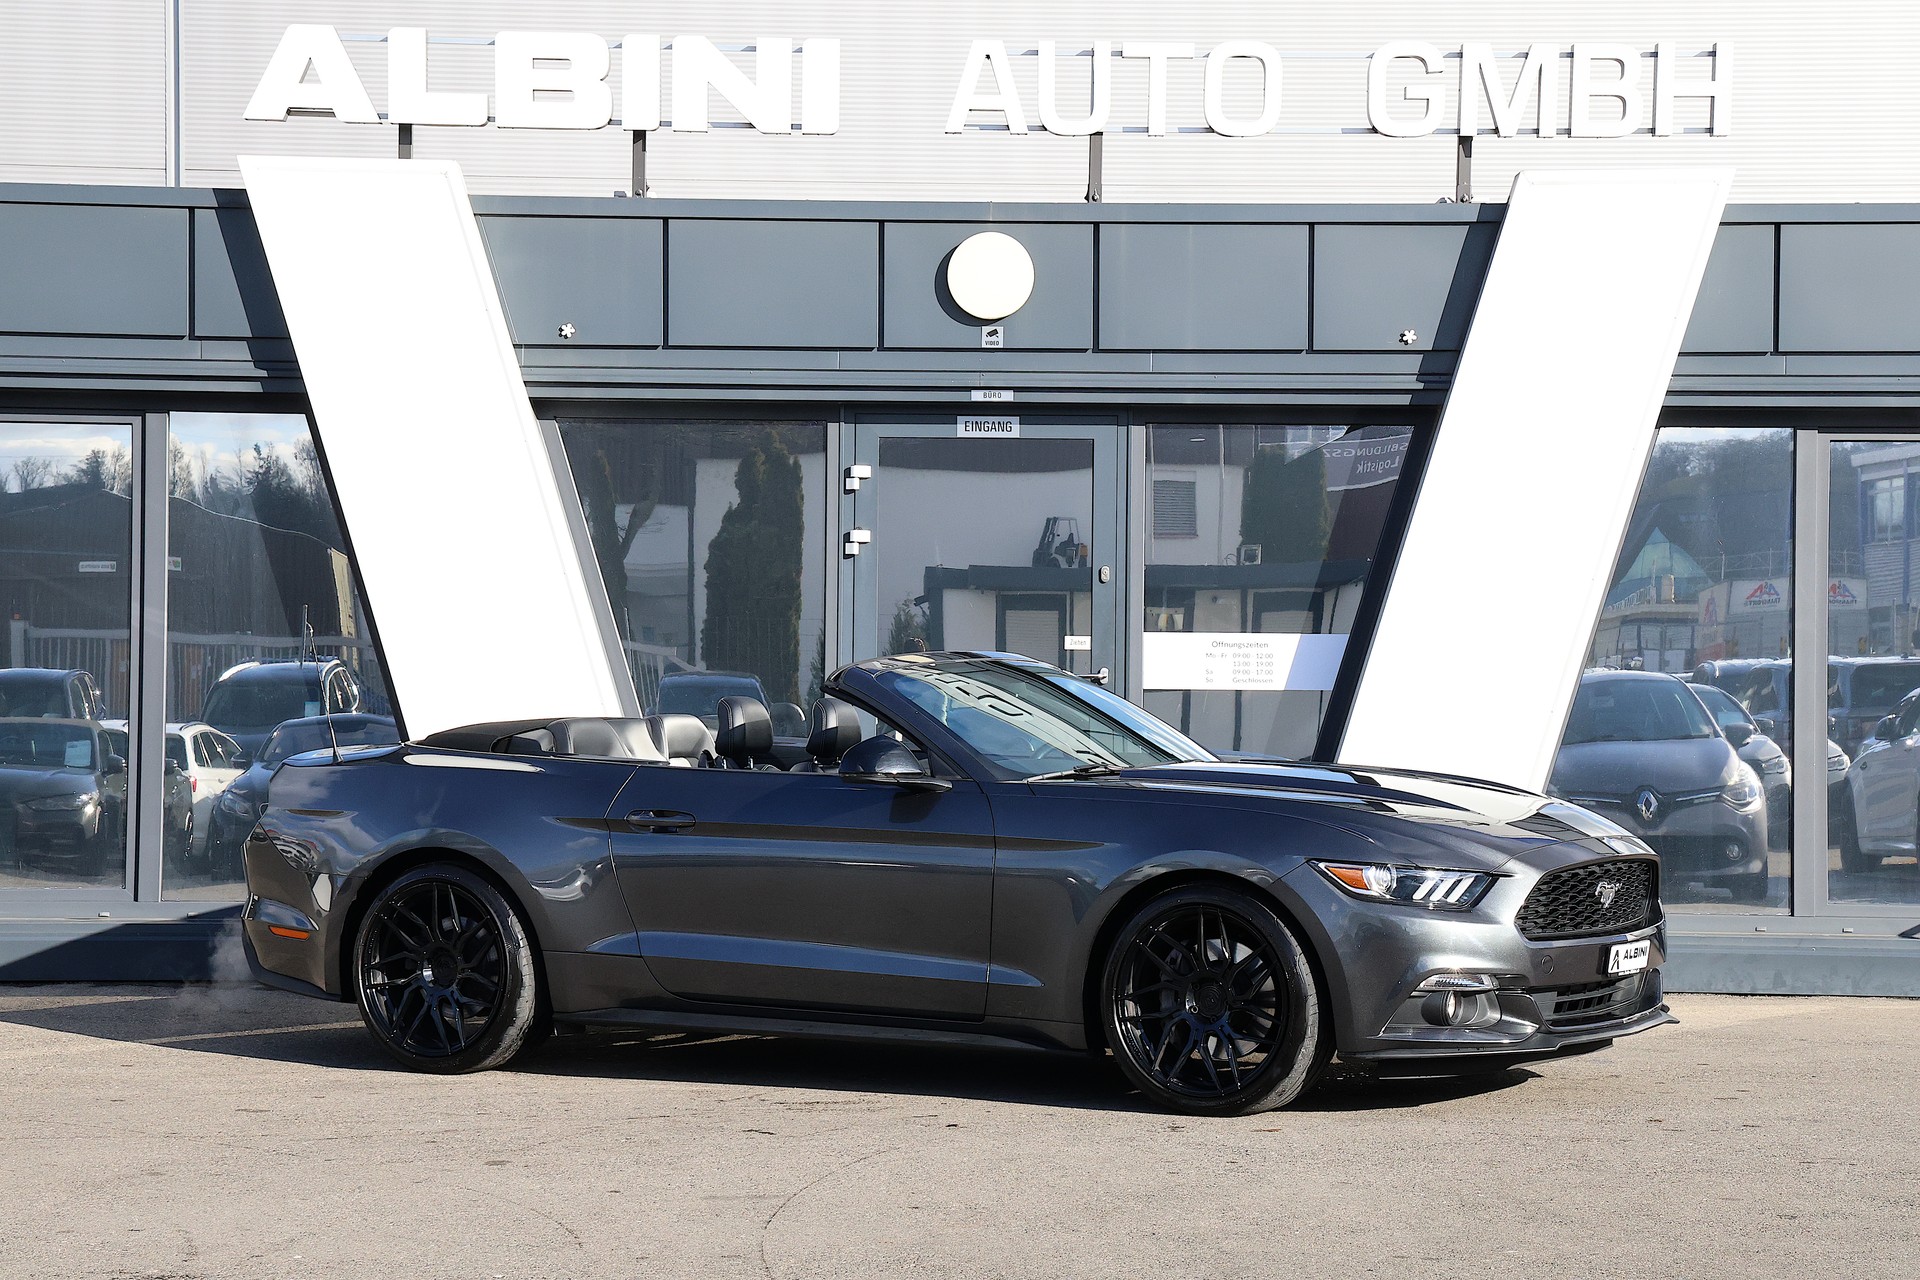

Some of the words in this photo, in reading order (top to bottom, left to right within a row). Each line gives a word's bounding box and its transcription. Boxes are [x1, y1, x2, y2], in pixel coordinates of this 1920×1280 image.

[242, 24, 841, 136] ALBINI
[945, 38, 1284, 138] AUTO
[1367, 40, 1734, 138] GMBH
[982, 391, 1002, 399] BÜRO
[964, 421, 1012, 433] EINGANG
[1623, 946, 1648, 960] ALBINI
